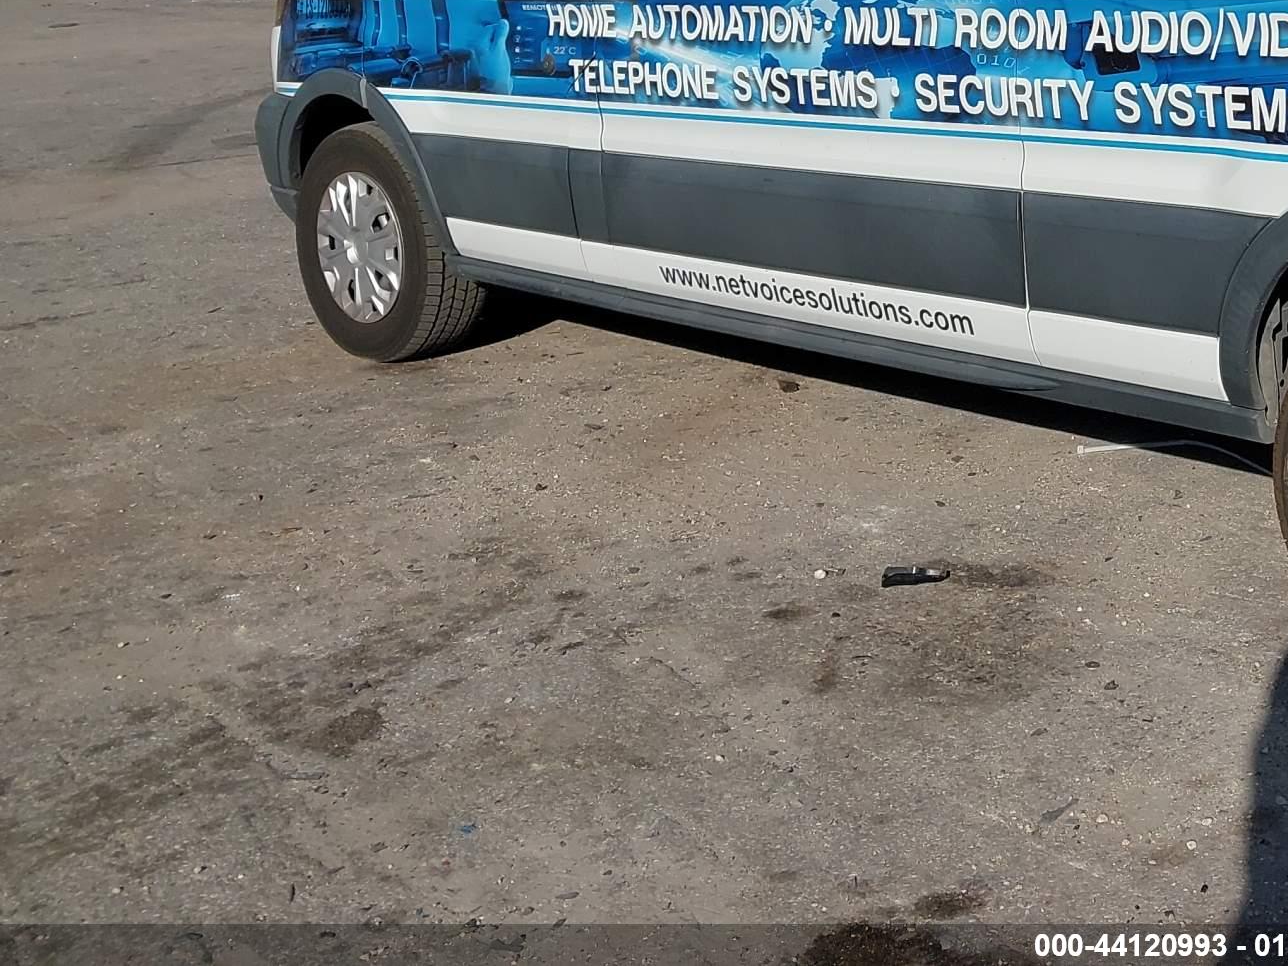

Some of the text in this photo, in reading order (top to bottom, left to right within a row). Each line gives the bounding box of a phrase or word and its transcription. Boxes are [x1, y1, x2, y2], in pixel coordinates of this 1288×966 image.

[546, 3, 617, 38] HOME
[629, 4, 814, 44] AUTOMATION
[843, 6, 938, 47] MULTI
[954, 7, 1067, 51] ROOM
[568, 59, 720, 100] TELEPHONE
[733, 66, 877, 110] SYSTEMS
[914, 72, 1096, 121] SECURITY
[658, 265, 975, 336] www.netvoicesolutions.com
